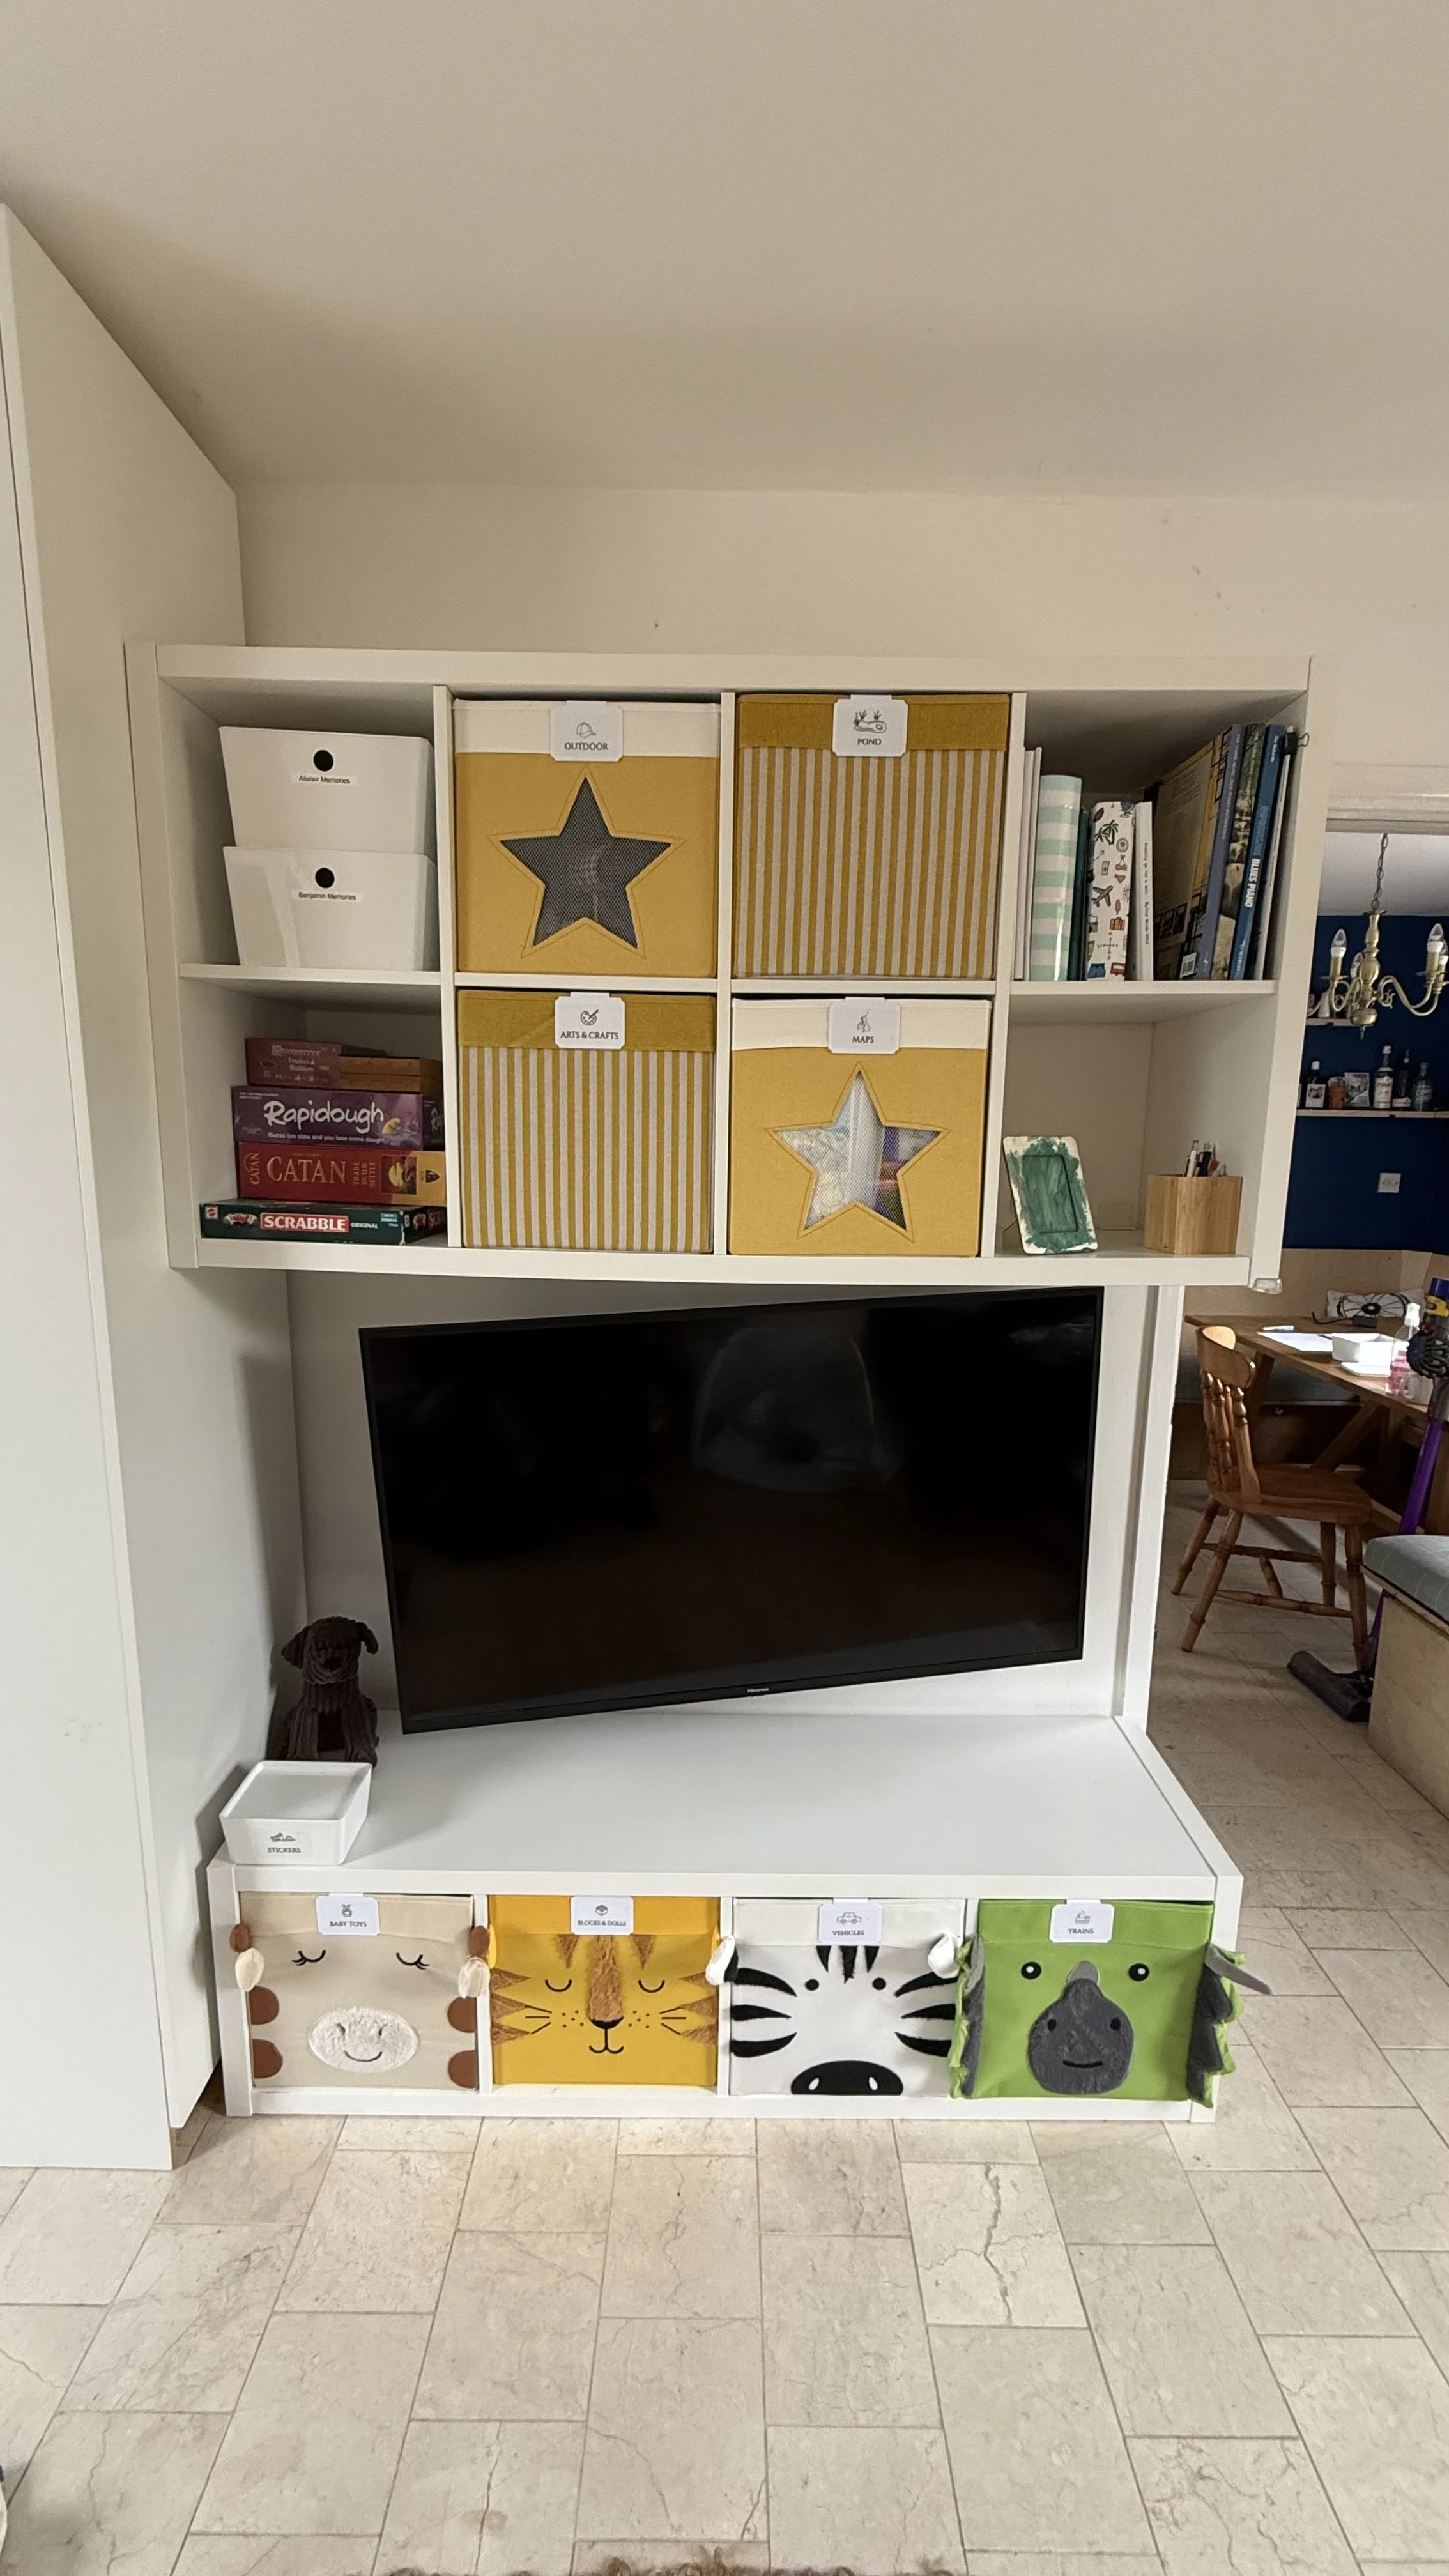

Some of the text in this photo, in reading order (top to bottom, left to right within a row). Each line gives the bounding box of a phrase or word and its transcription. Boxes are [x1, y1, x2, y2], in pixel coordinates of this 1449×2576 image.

[564, 742, 609, 751] OUTDOOR
[321, 776, 351, 784] Memories
[1248, 859, 1261, 882] BLUES
[298, 891, 326, 900] Benjamin
[1245, 883, 1257, 907] PIANO
[560, 1031, 580, 1039] ARTS
[588, 1031, 619, 1039] CRAFTS
[263, 1100, 384, 1135] Rapidough
[250, 1153, 259, 1184] CATAN
[266, 1156, 346, 1184] CATAN
[264, 1216, 346, 1230] SCRABBLE
